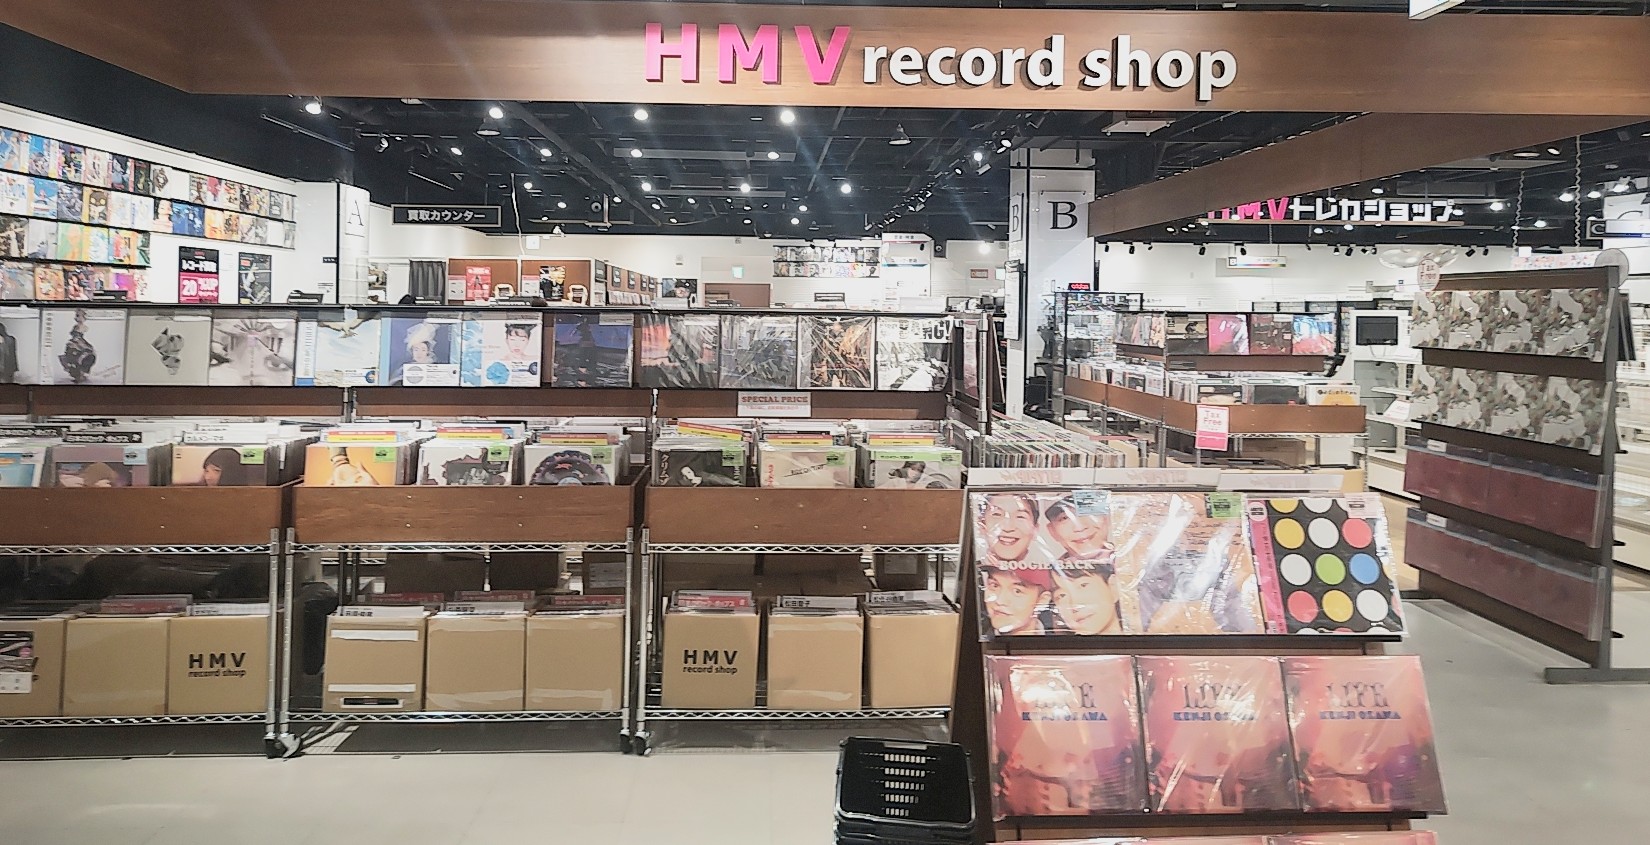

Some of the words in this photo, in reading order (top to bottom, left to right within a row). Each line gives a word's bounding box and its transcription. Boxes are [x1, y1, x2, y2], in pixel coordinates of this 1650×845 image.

[645, 23, 851, 84] HMV
[864, 35, 1064, 87] record
[1085, 35, 1237, 101] shop
[347, 200, 364, 226] A
[407, 209, 486, 221] 買取カウンター
[1048, 201, 1078, 229] B
[1290, 197, 1454, 221] トレカショップ
[1011, 204, 1020, 232] B
[741, 395, 780, 403] SPECIAL
[999, 560, 1053, 571] BOOGIE
[188, 652, 246, 668] HMV
[683, 649, 738, 665] HMV
[188, 669, 220, 677] record
[222, 669, 247, 678] shop
[682, 665, 713, 674] record
[714, 665, 738, 675] shop
